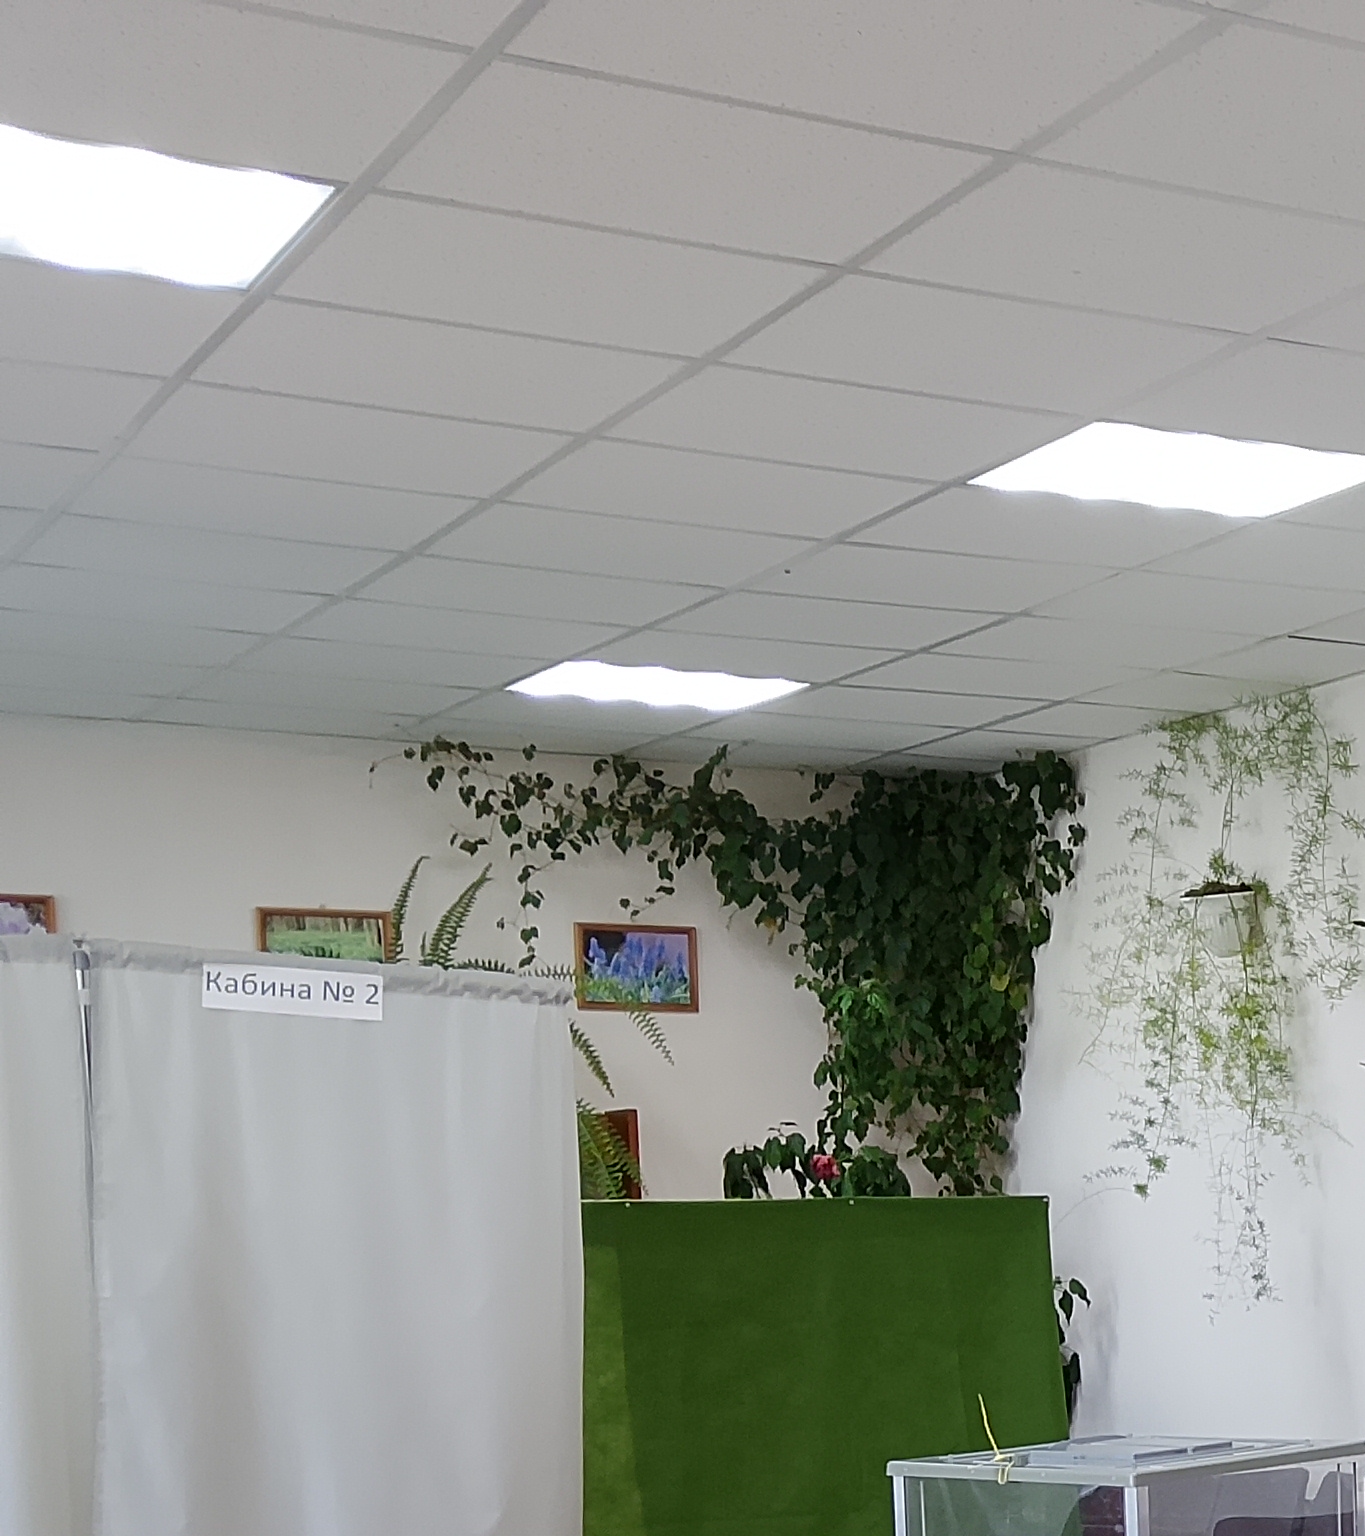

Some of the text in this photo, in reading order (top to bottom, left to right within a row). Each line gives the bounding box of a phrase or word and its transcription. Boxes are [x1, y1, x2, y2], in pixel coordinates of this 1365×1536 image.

[205, 971, 380, 1005] Кабина № 2
